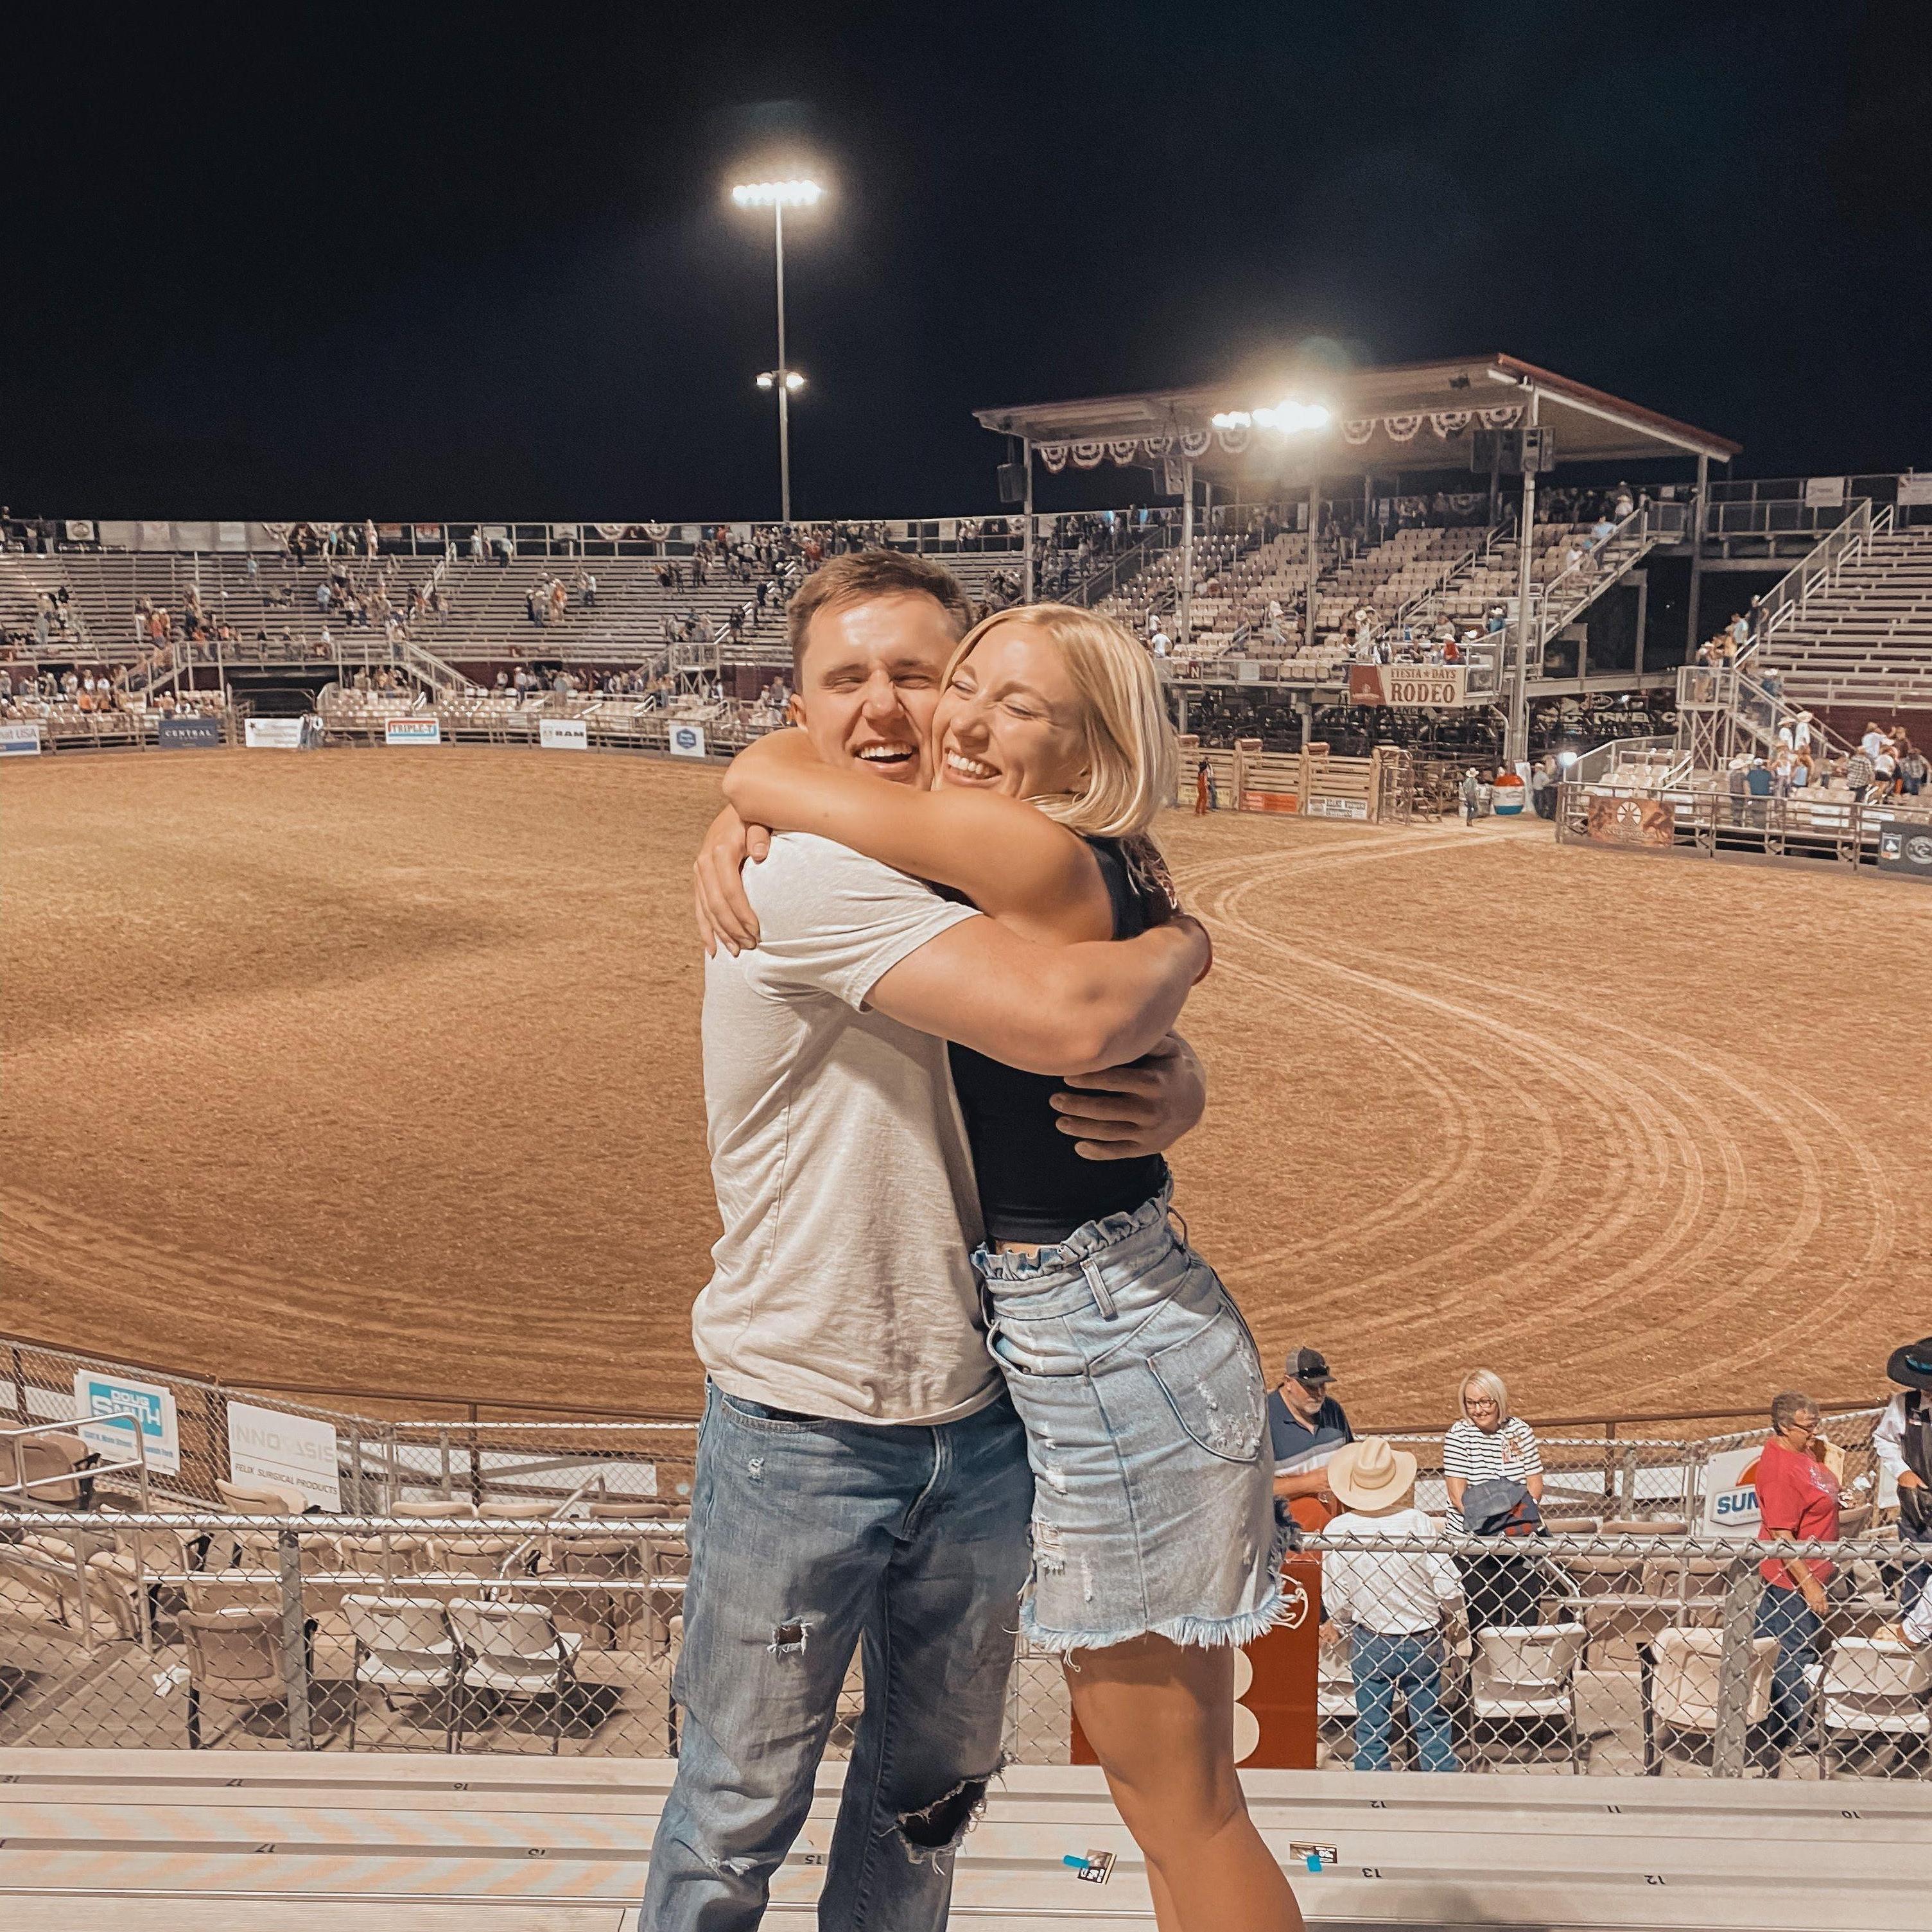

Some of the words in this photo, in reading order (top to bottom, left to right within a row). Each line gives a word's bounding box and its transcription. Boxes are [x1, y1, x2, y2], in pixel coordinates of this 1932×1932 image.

[1391, 668, 1421, 679] FIESTA
[1432, 668, 1456, 679] DAYS
[1390, 683, 1456, 704] RODEO
[164, 729, 212, 737] CENTRAL
[110, 1389, 149, 1406] DOUG
[257, 1468, 294, 1485] SURGICAL
[296, 1477, 338, 1495] PRODUCTS
[1369, 1800, 1387, 1809] 12
[1606, 1805, 1622, 1814] 11
[1841, 1811, 1861, 1819] 10
[255, 1843, 276, 1853] 17
[805, 1854, 822, 1865] 15
[1361, 1868, 1382, 1878] 13
[1643, 1875, 1666, 1885] 12
